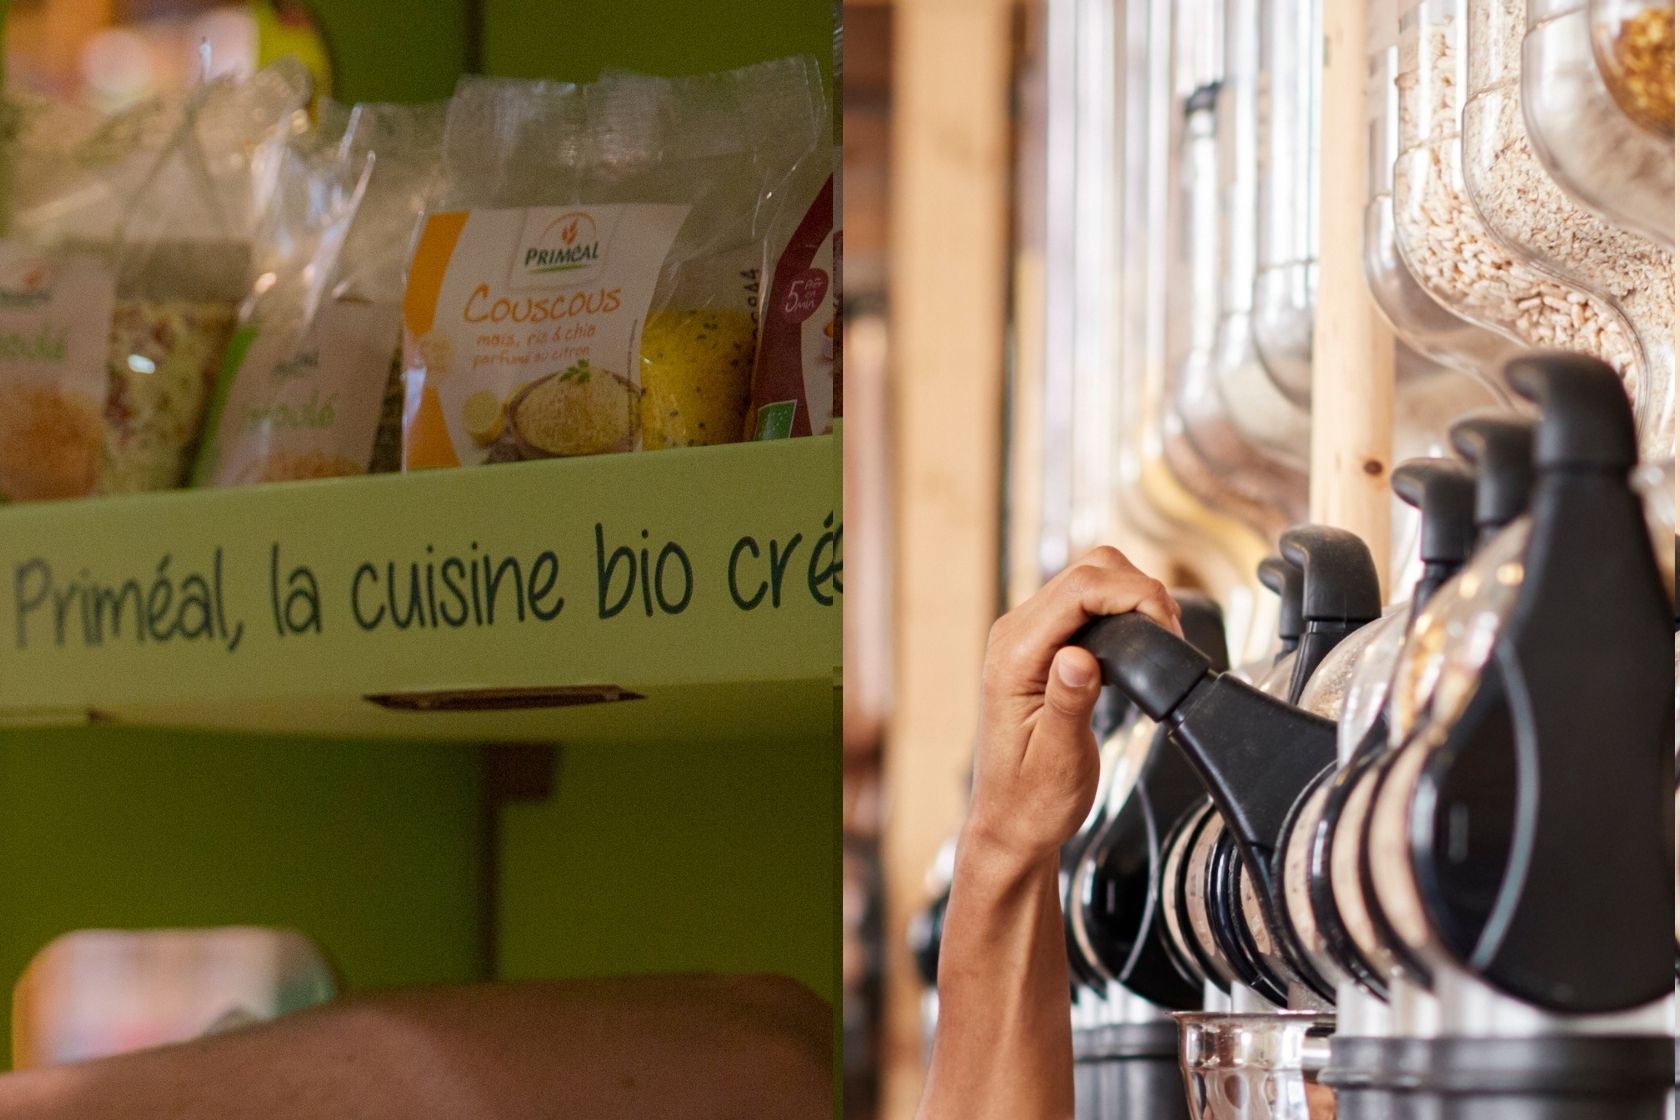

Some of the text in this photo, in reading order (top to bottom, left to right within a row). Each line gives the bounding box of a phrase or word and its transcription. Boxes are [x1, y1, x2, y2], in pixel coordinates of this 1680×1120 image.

[785, 280, 804, 312] 5
[15, 547, 245, 653] Priméal,
[272, 543, 322, 636] la
[351, 541, 564, 631] cuisine
[595, 522, 693, 619] bio
